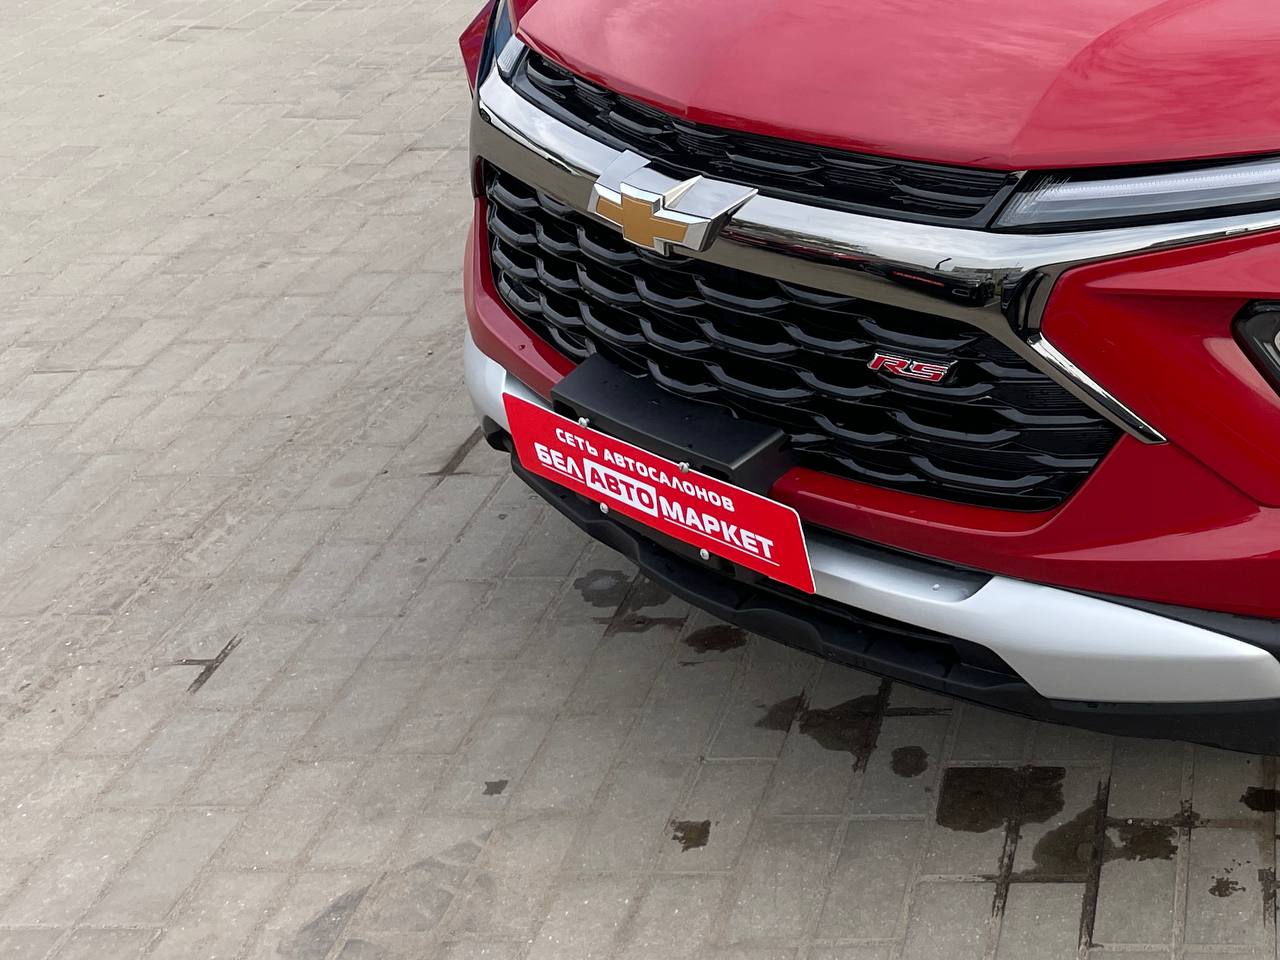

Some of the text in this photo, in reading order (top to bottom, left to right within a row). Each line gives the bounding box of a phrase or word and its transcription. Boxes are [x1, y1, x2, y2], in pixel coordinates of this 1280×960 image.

[867, 352, 950, 382] RS
[534, 442, 774, 559] БЕЛ АВТО МАРКЕТ
[555, 428, 735, 512] СЕТЬ АВТОСАЛОНОВ
